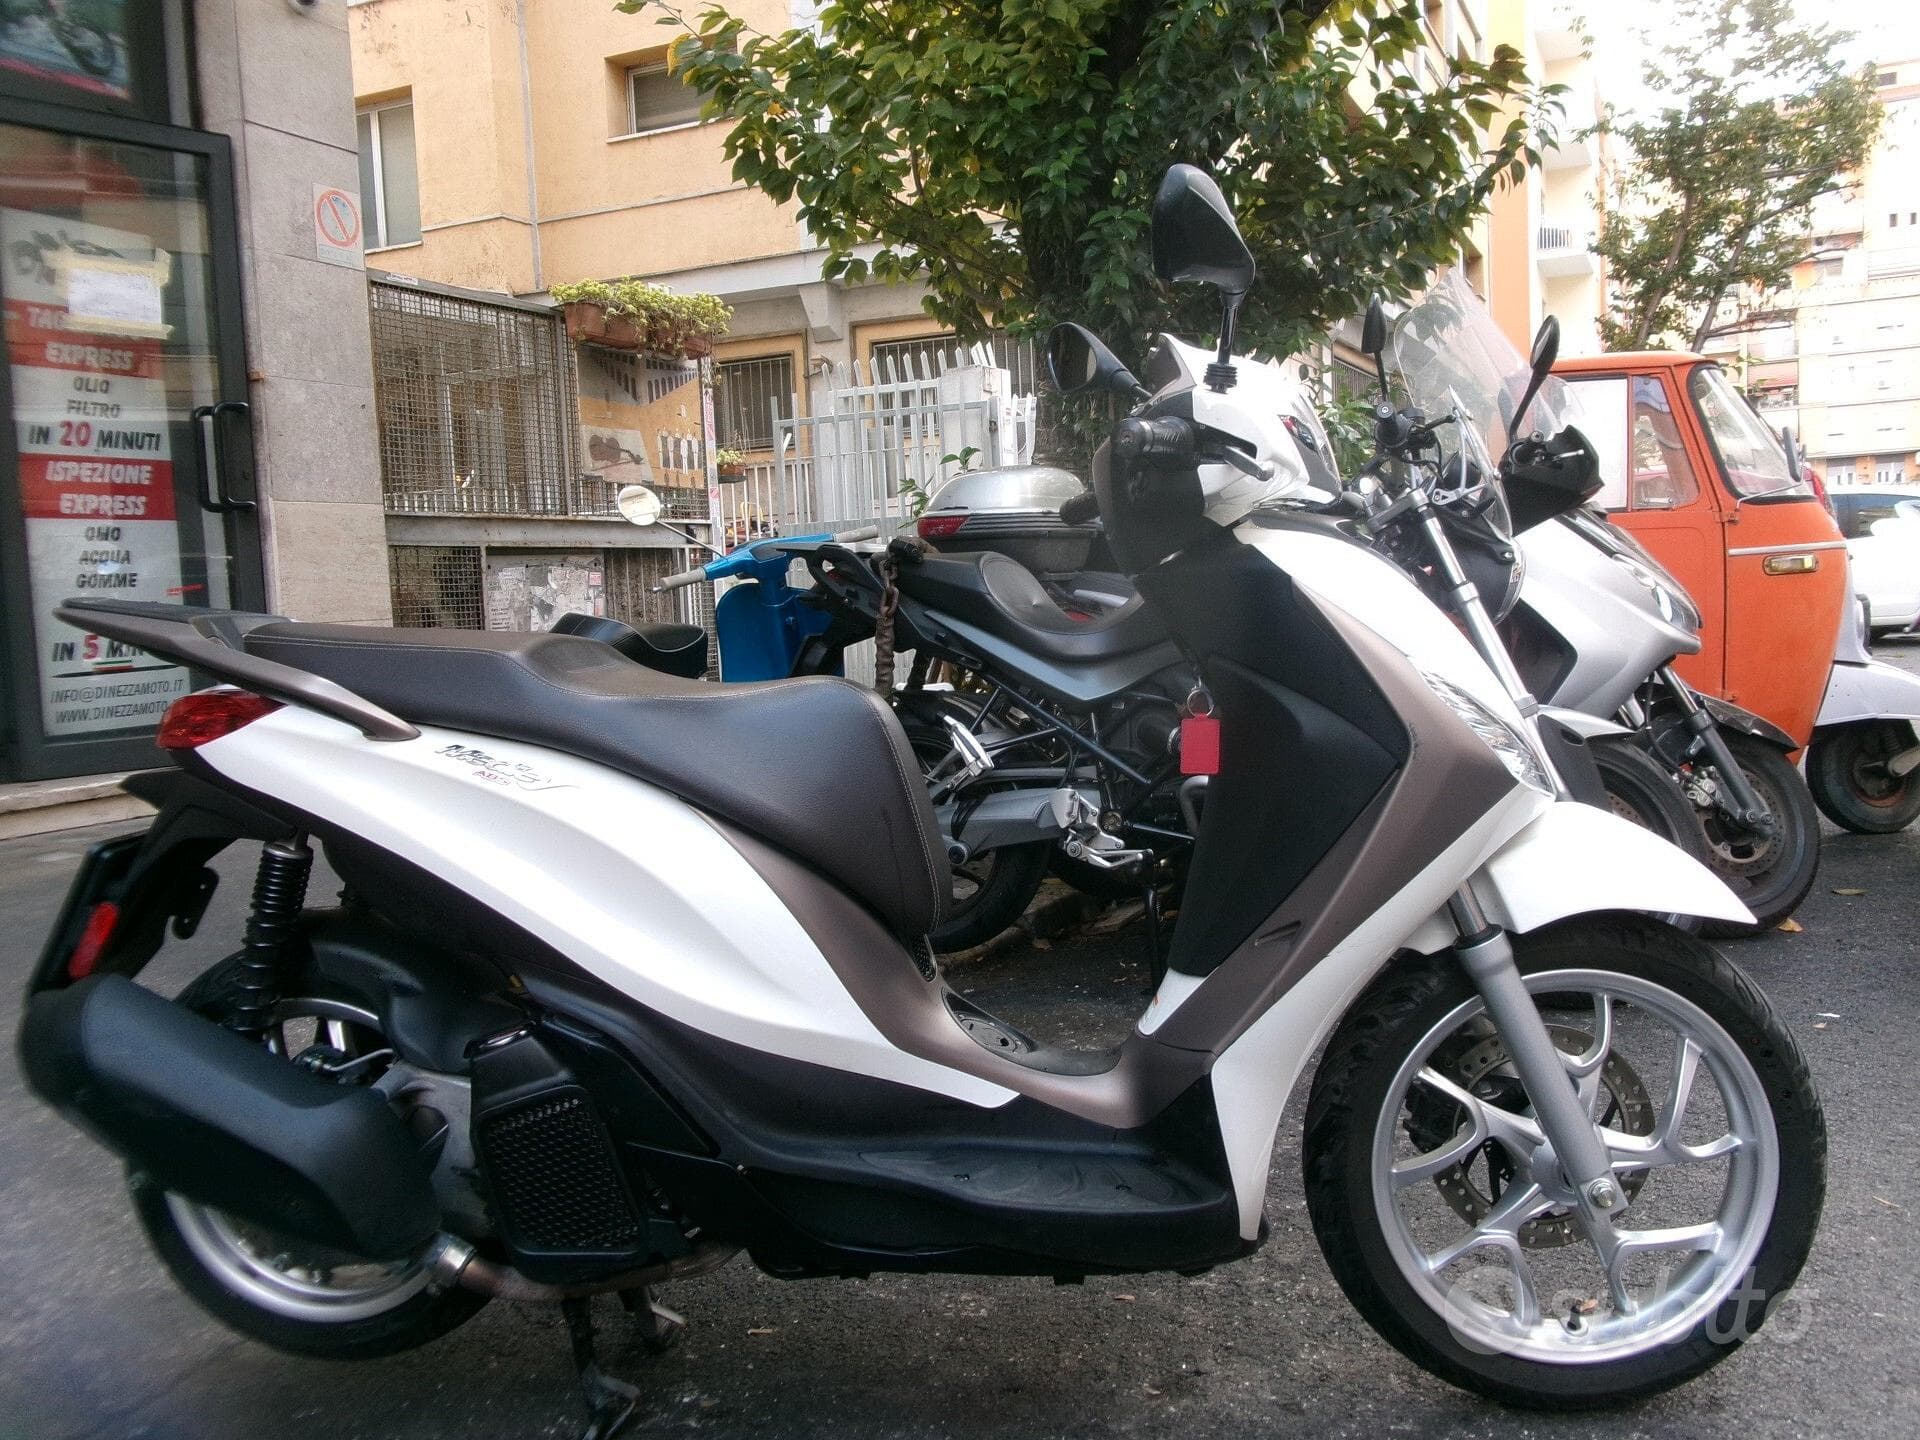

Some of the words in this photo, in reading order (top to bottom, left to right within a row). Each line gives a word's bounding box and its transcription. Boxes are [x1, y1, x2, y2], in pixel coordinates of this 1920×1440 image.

[46, 341, 134, 370] EXPRESS
[73, 376, 110, 394] OLIO
[66, 399, 121, 419] FILTRO
[28, 425, 50, 445] IN
[58, 420, 92, 447] 20
[96, 430, 161, 451] MINUTI
[46, 461, 153, 485] ISPEZIONE
[59, 493, 147, 515] EXPRESS
[76, 573, 138, 589] GOMME
[52, 642, 75, 662] IN
[82, 634, 99, 660] 5
[50, 679, 184, 703] INFO@DINEZZAMOTO.IT
[55, 701, 168, 725] WWW.DINEZZAMOTO
